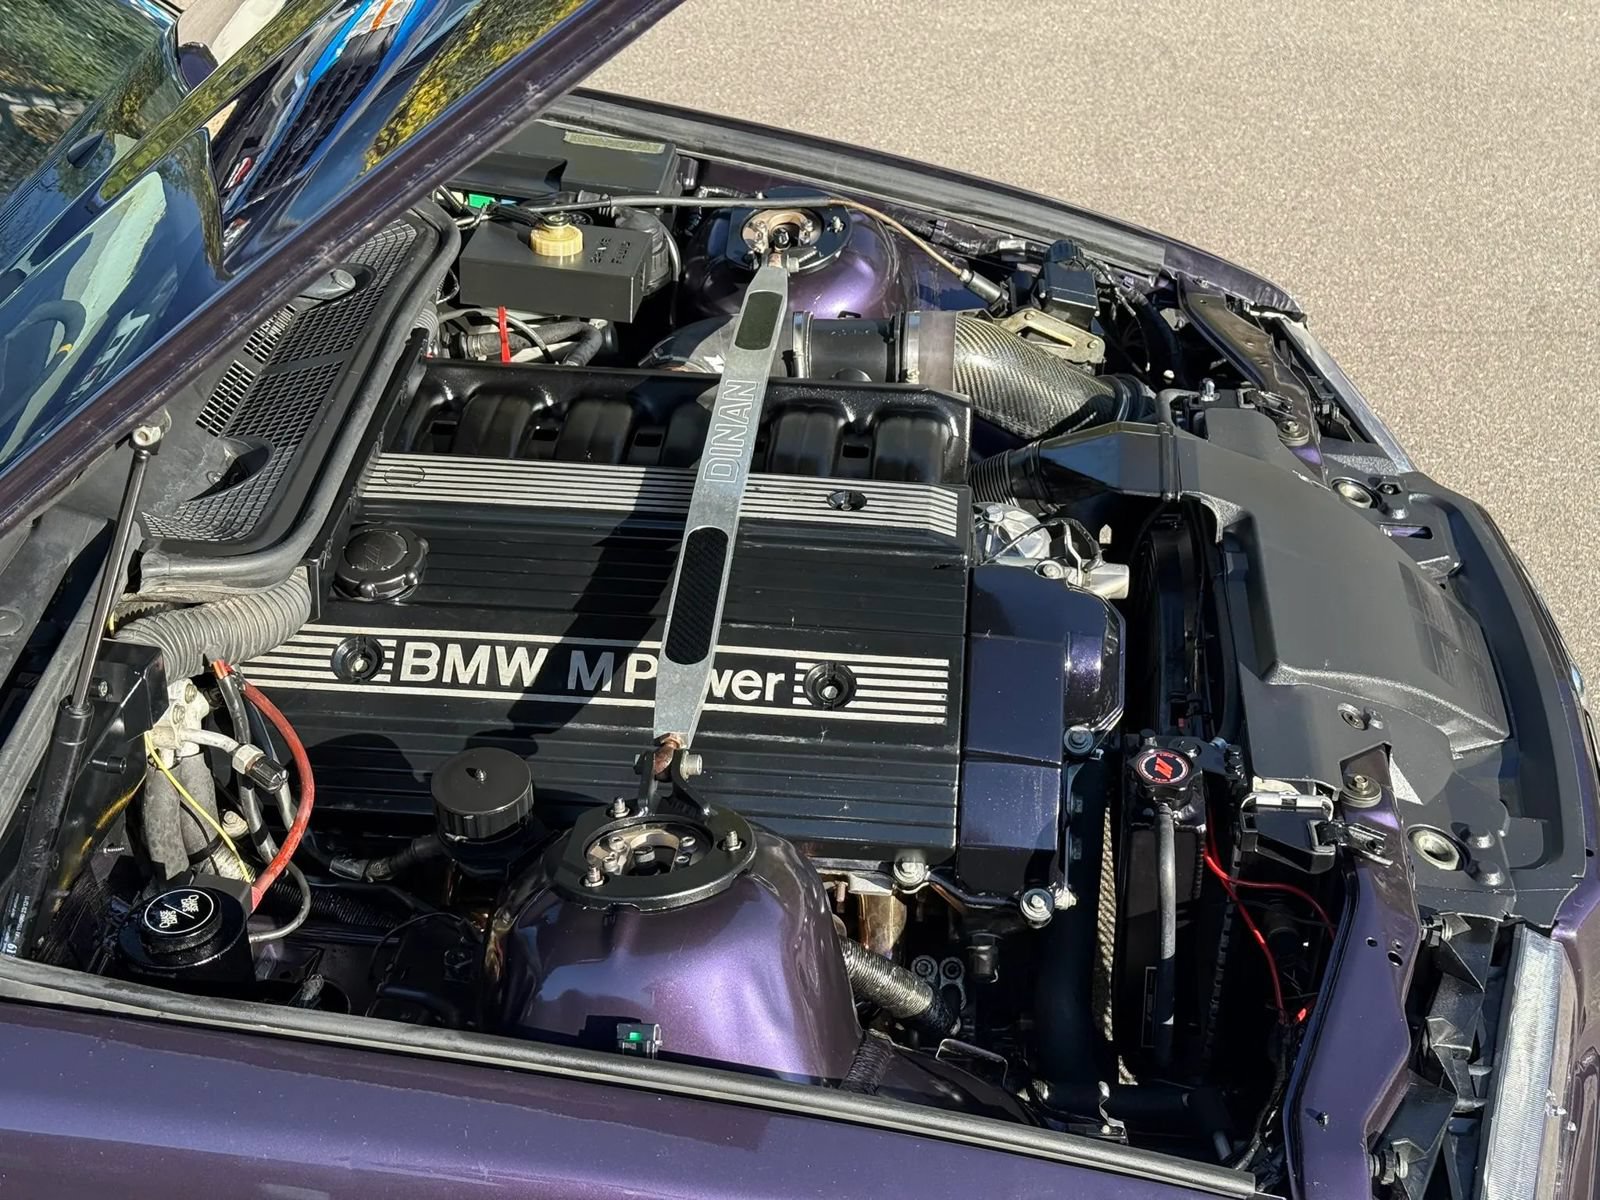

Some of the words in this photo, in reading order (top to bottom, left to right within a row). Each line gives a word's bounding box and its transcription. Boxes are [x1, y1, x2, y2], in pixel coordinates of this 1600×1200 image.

[703, 379, 758, 483] DINAN
[399, 641, 549, 687] BMW
[567, 650, 615, 693] M
[624, 653, 786, 702] Pwer
